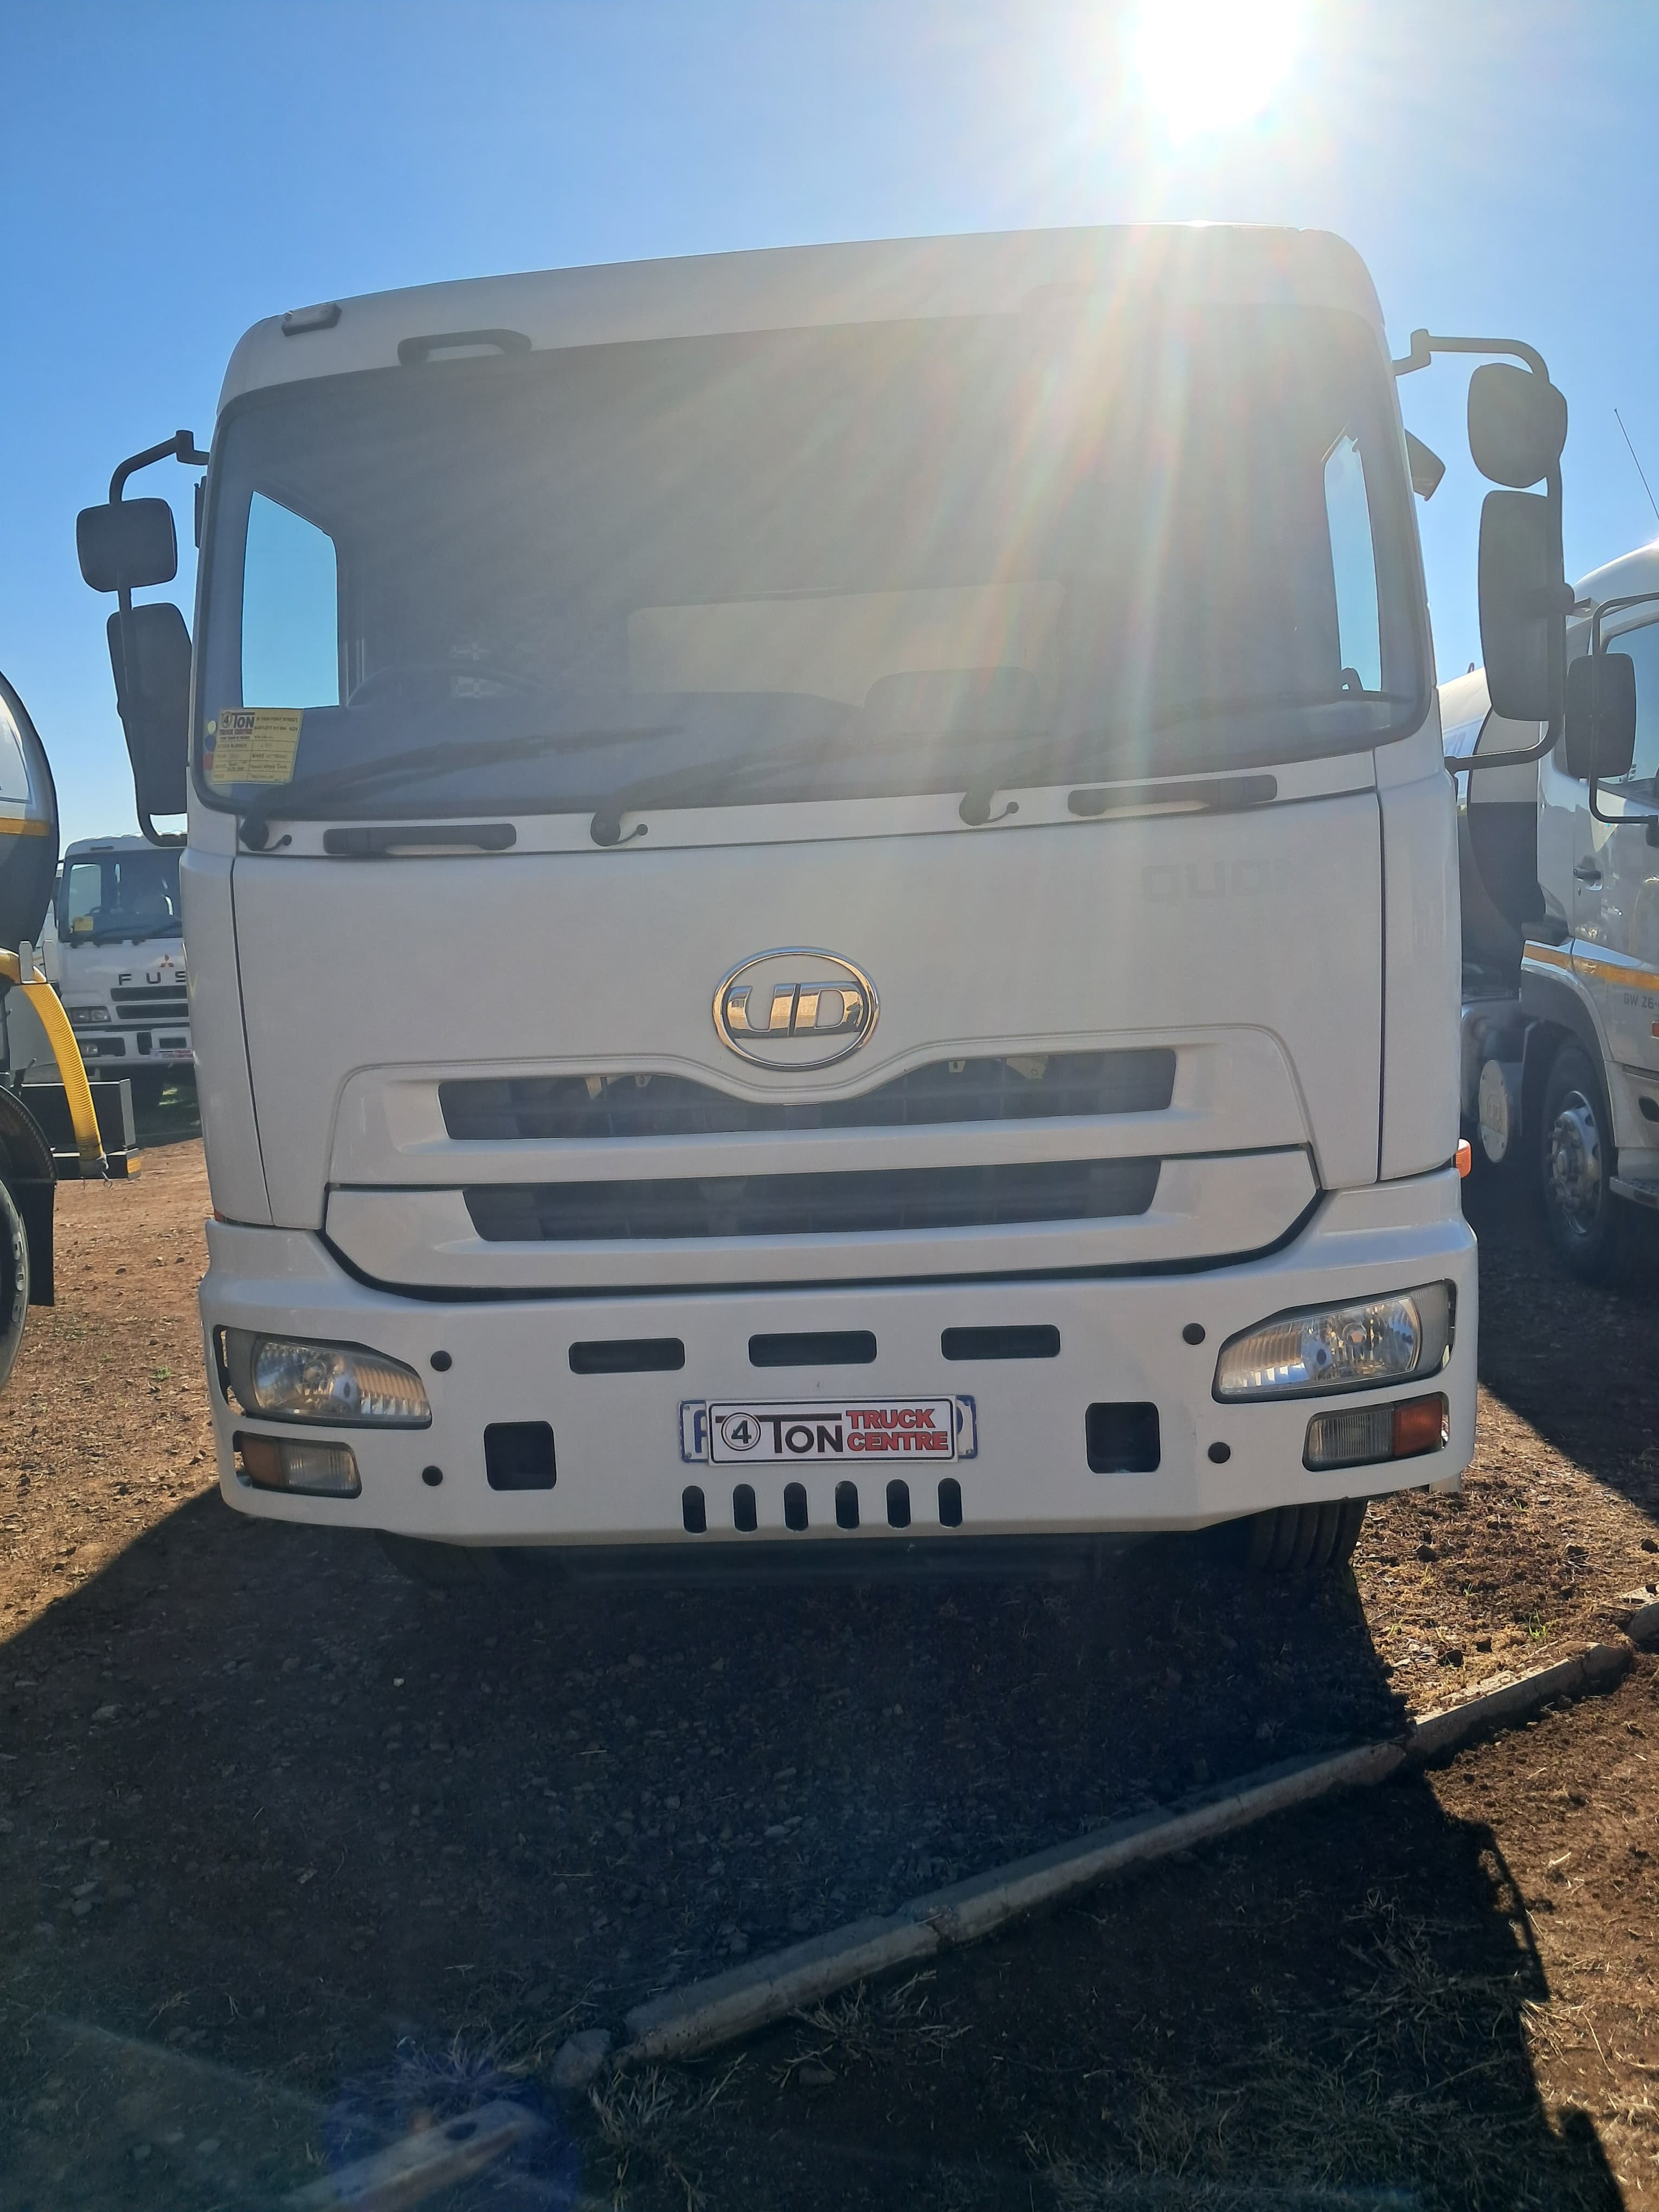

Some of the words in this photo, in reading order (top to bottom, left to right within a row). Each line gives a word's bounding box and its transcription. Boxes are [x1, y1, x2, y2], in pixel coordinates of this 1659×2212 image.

[232, 712, 255, 729] TON
[118, 970, 186, 986] FUS
[846, 1409, 936, 1429] TRUCK
[731, 1420, 752, 1444] 4
[760, 1413, 844, 1454] TON
[847, 1431, 948, 1451] CENTRE
